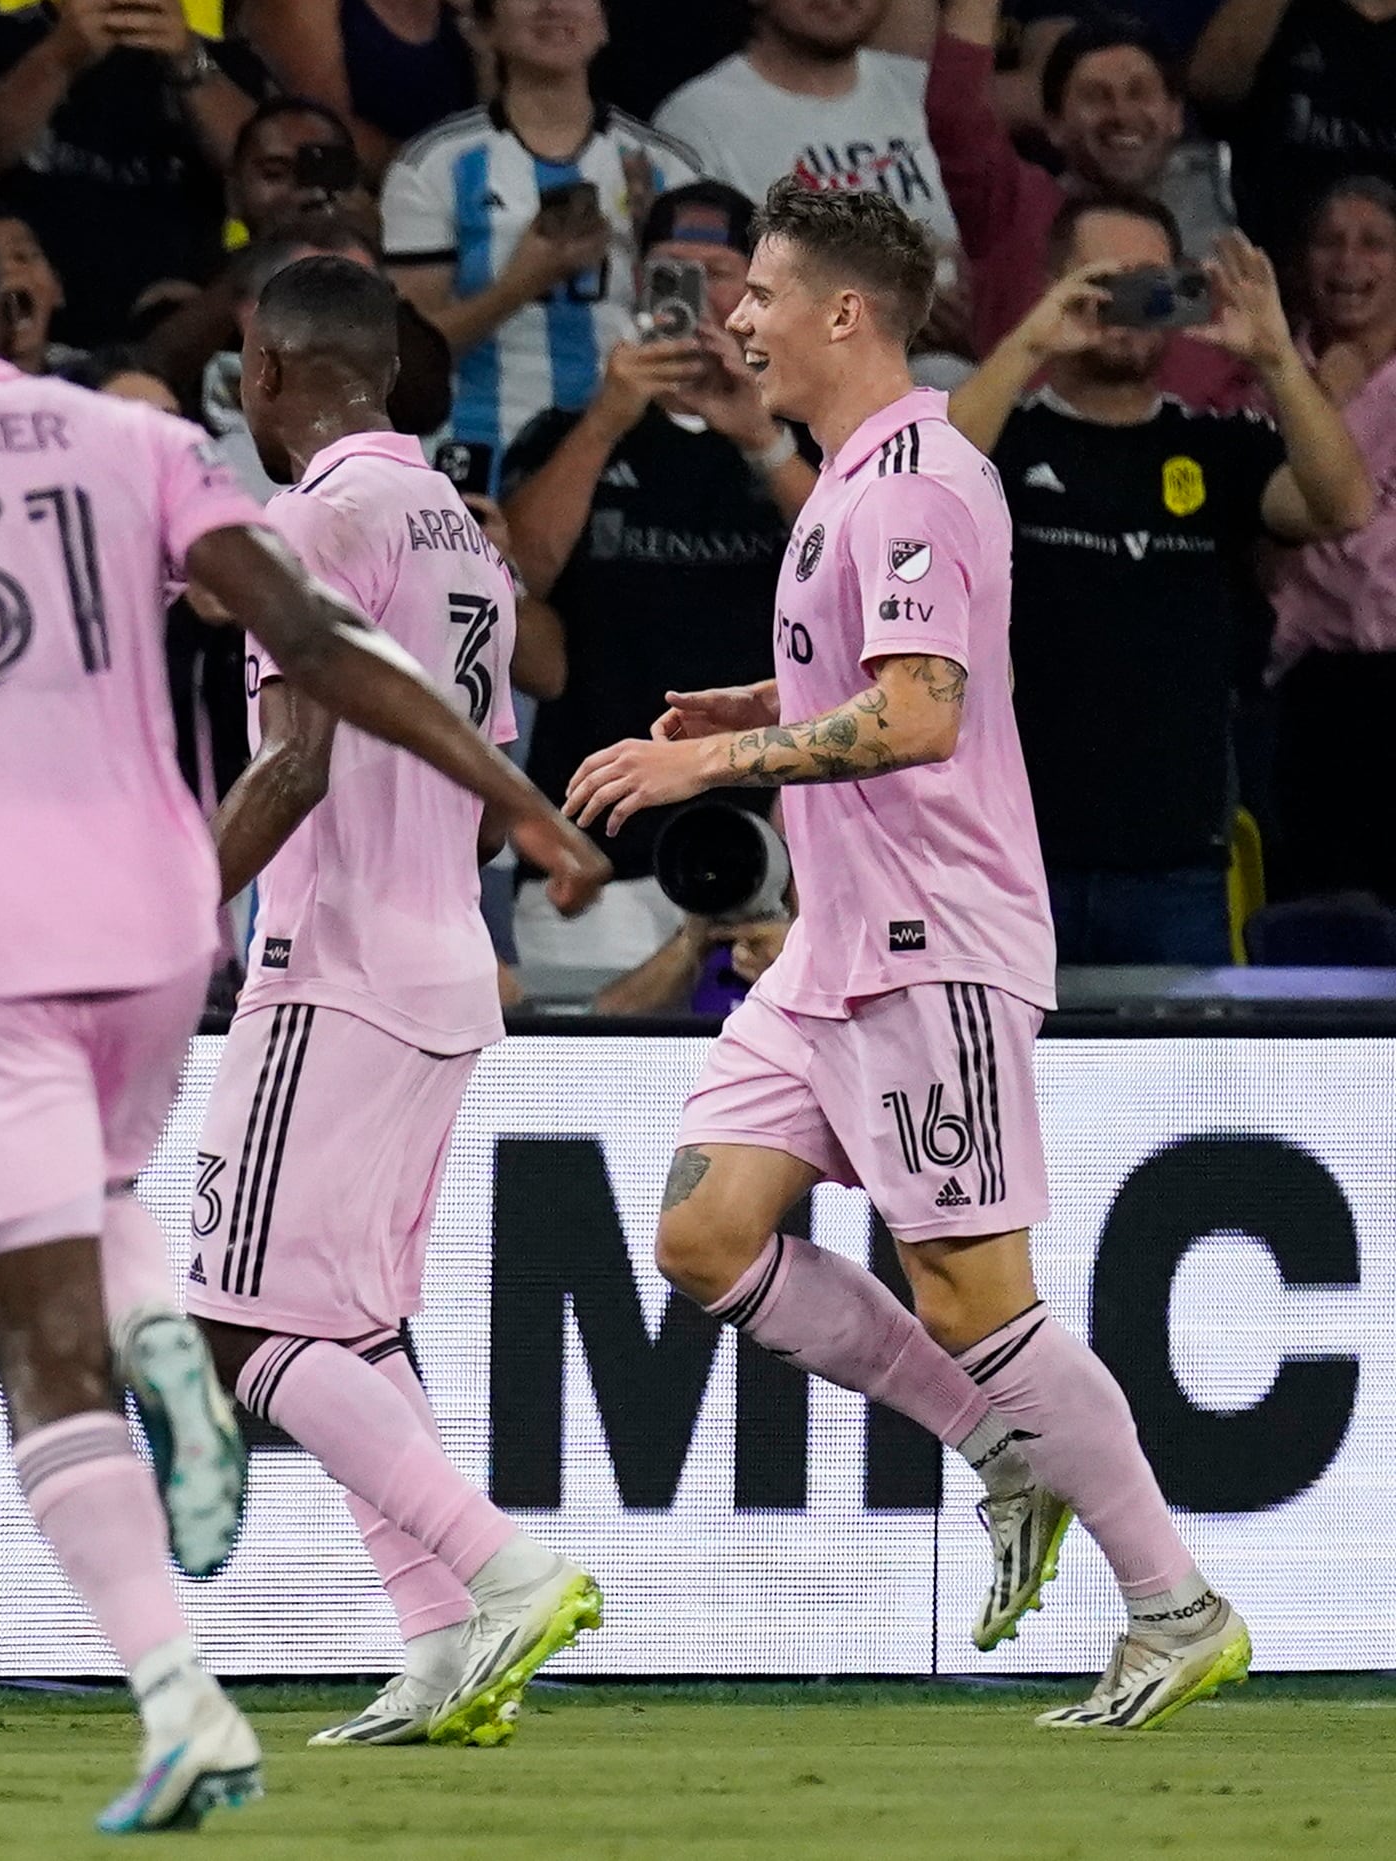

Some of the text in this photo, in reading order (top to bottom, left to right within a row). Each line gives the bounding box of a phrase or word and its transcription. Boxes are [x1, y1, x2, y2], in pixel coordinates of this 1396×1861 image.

[903, 597, 934, 622] tv
[448, 592, 499, 730] 3
[882, 1083, 973, 1174] 16
[192, 1152, 226, 1241] 3
